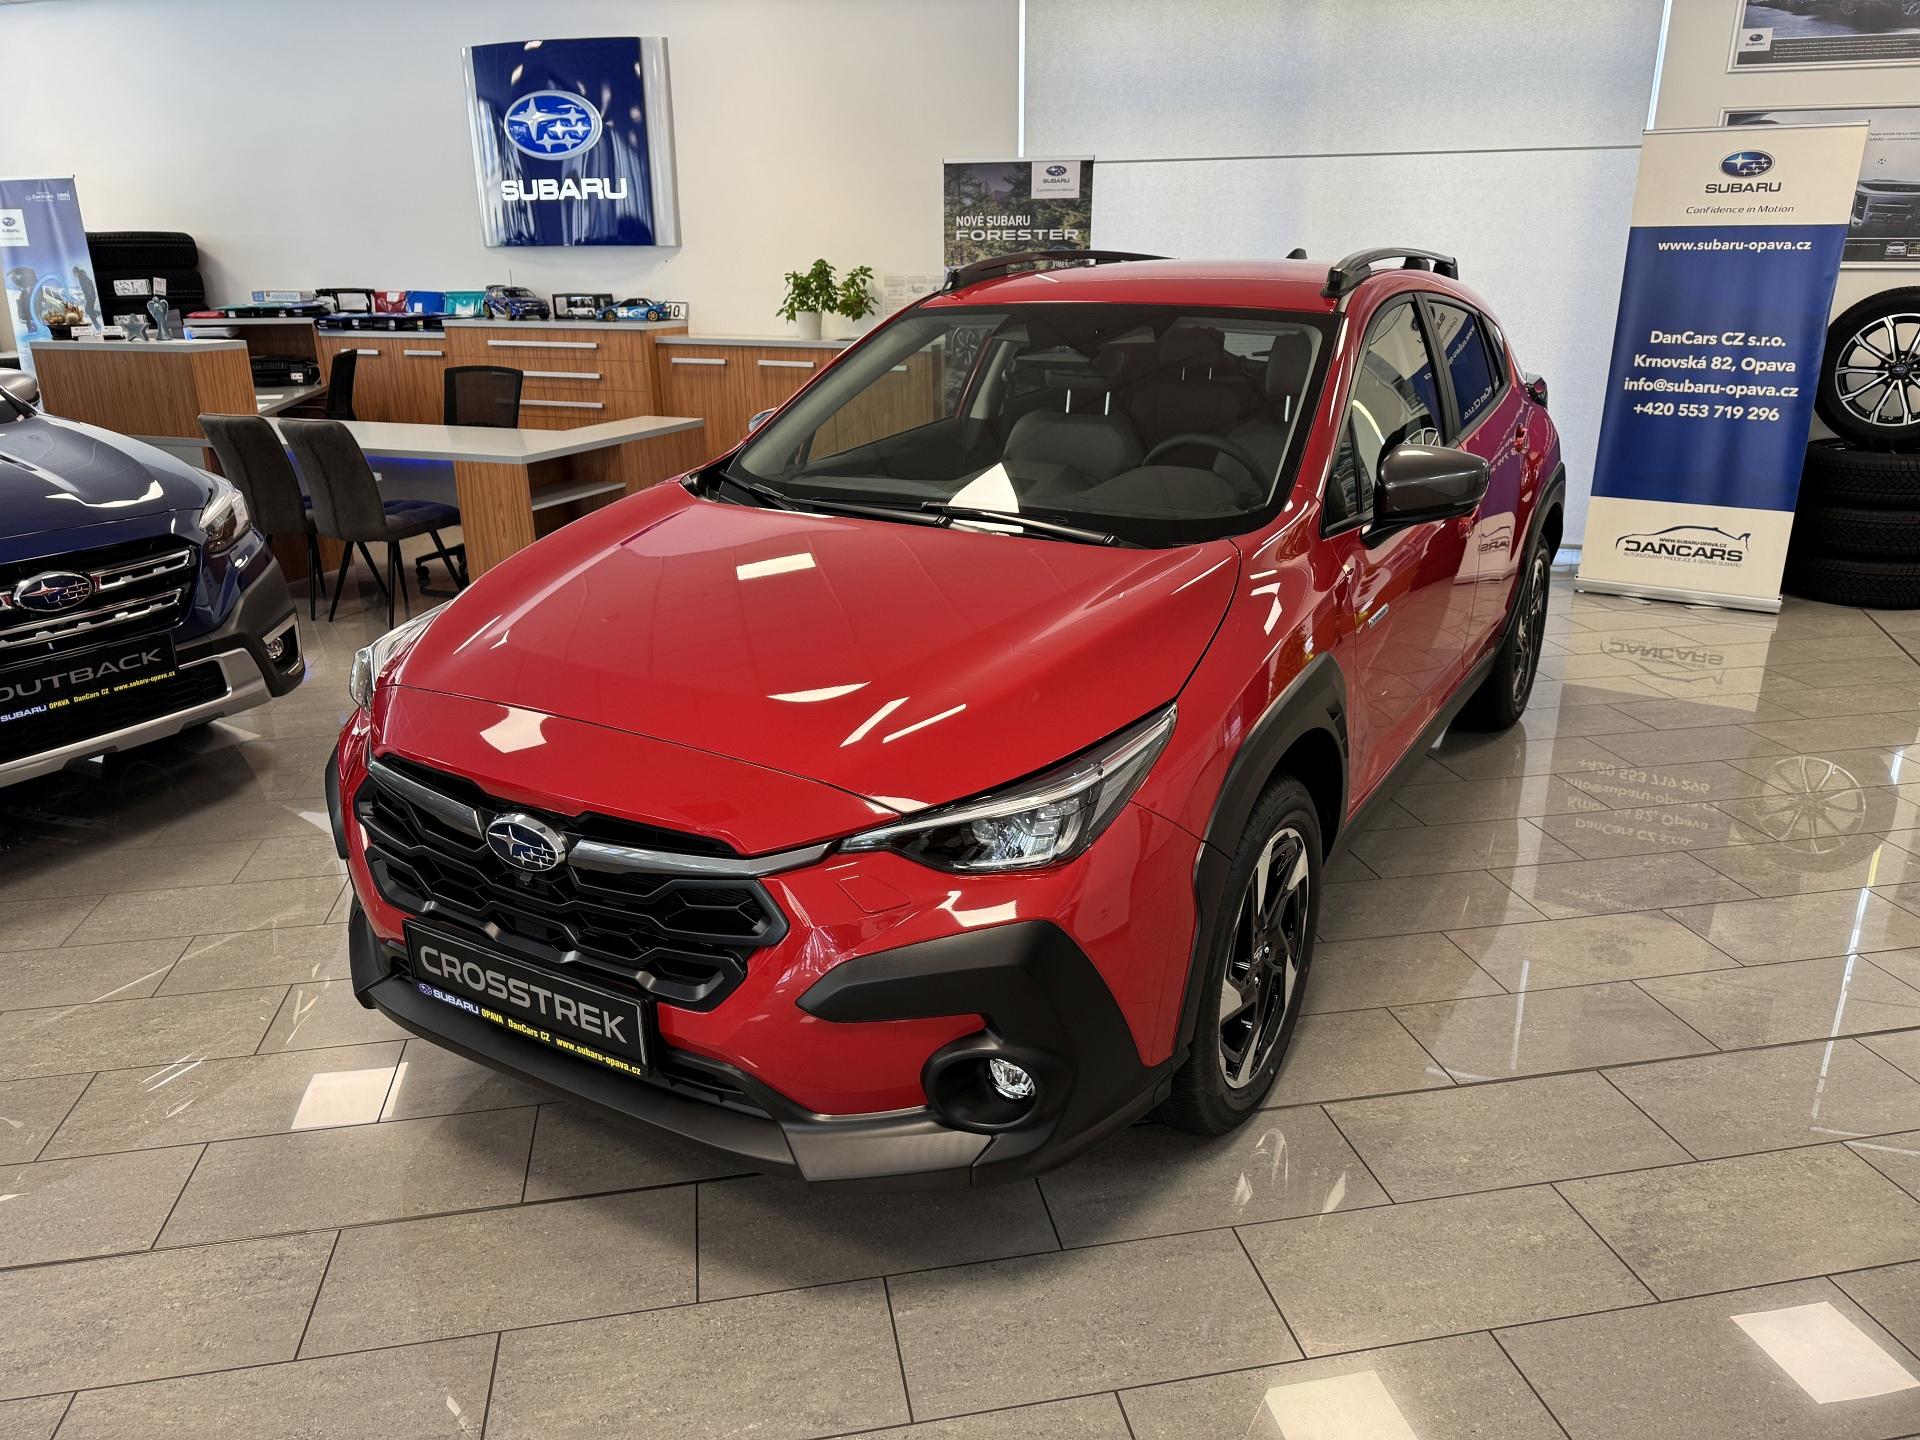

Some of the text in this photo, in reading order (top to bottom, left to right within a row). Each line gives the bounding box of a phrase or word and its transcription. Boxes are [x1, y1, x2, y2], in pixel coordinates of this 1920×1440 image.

[501, 178, 628, 200] SUBARU
[1704, 182, 1782, 194] SUBARU
[956, 212, 1030, 226] NOVÉ SUBARU
[1686, 205, 1794, 214] Confidence in Motion
[956, 229, 1079, 241] FORESTER
[1658, 239, 1812, 253] www.subaru-opava.cz
[1650, 331, 1786, 346] DanCars CZ s.r.o.
[1634, 354, 1796, 374] Krnovská 82, Opava
[1624, 378, 1800, 398] info@subaru-opava.cz
[1633, 402, 1780, 421] +420 553 719 296
[1624, 540, 1743, 562] DANCARS
[0, 648, 162, 701] OUTBACK
[0, 671, 176, 722] SUBARU OPAVA DanCars CZ www.subaru-opava.cz
[420, 945, 628, 1044] CROSSTREK
[432, 989, 641, 1076] SUBARU OPAVA DanCars CZ www.subaru-opava.cz
